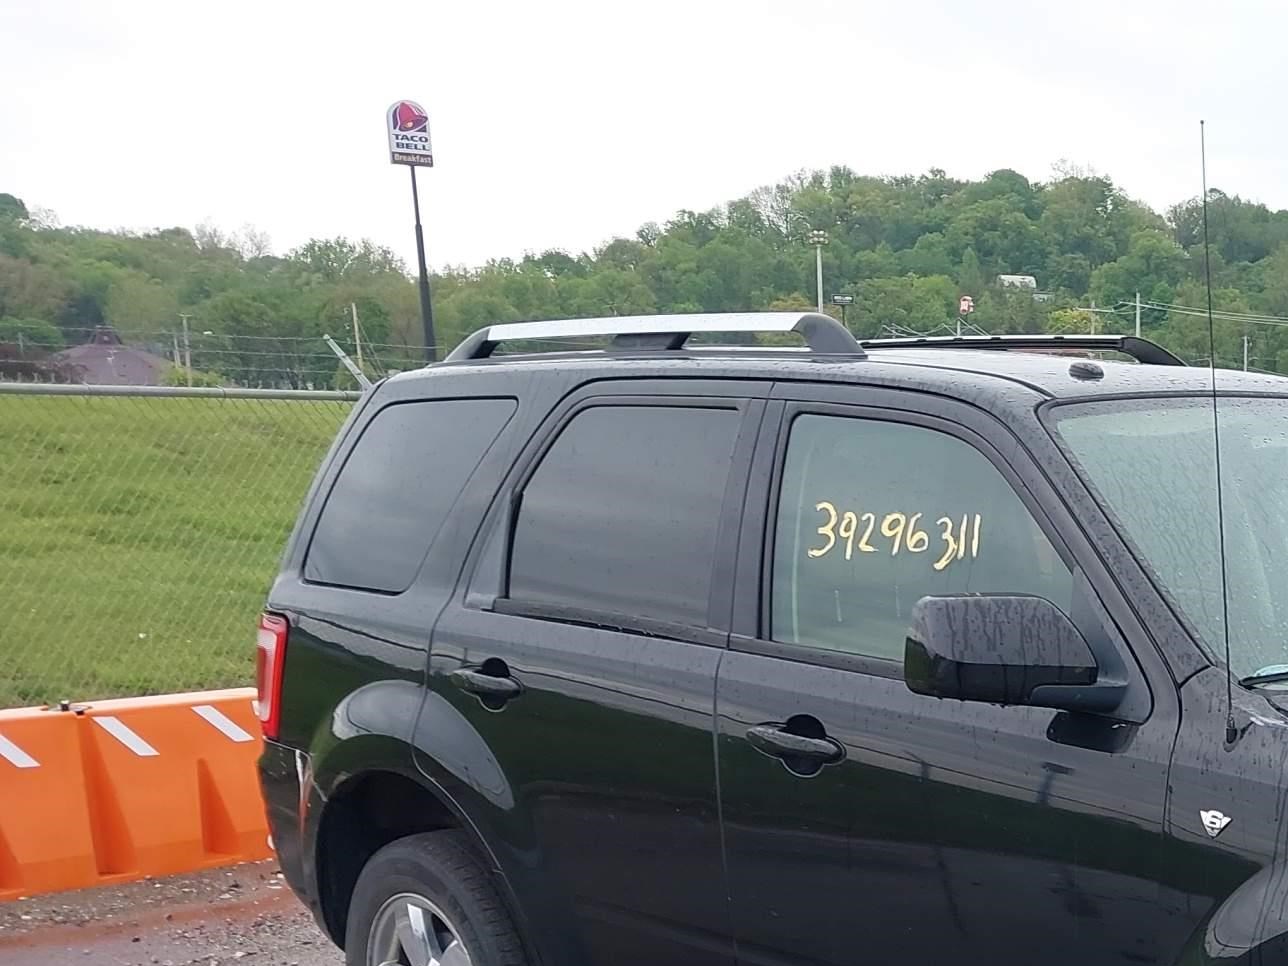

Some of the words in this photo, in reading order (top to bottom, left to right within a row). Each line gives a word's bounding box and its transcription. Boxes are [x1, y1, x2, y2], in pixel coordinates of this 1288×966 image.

[392, 133, 429, 143] TACO
[396, 142, 430, 151] BELL
[393, 153, 432, 164] Breakfast
